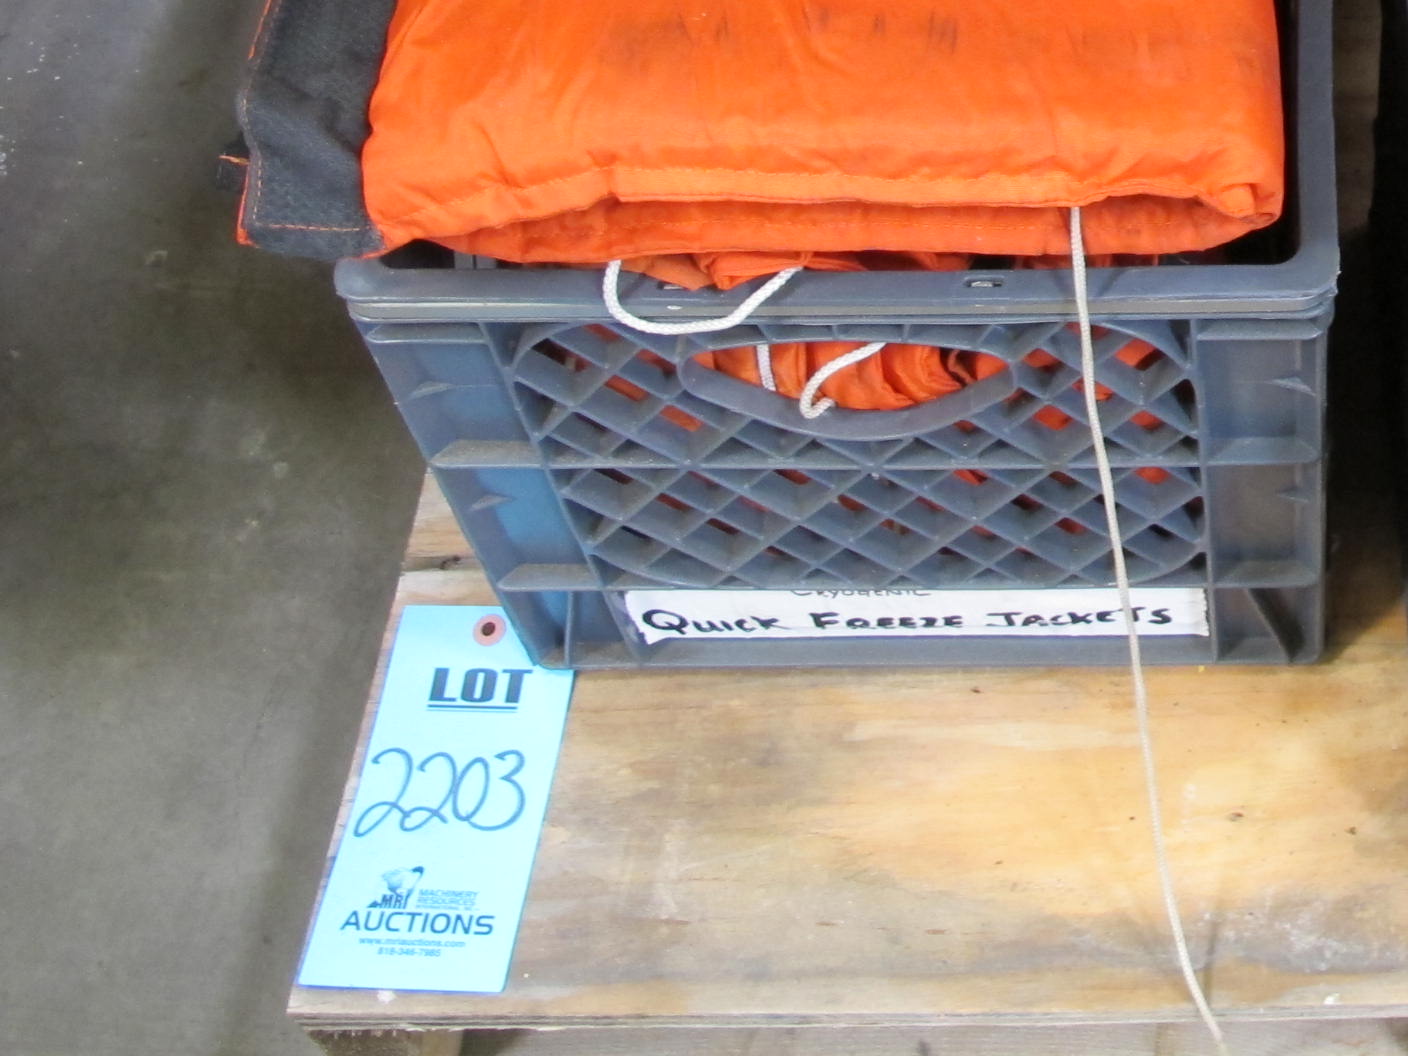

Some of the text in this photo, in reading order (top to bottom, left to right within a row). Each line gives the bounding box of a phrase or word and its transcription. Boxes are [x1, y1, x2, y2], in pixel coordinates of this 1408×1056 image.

[429, 667, 534, 704] LOT
[354, 747, 526, 838] 2203
[340, 910, 496, 935] AUCTIONS
